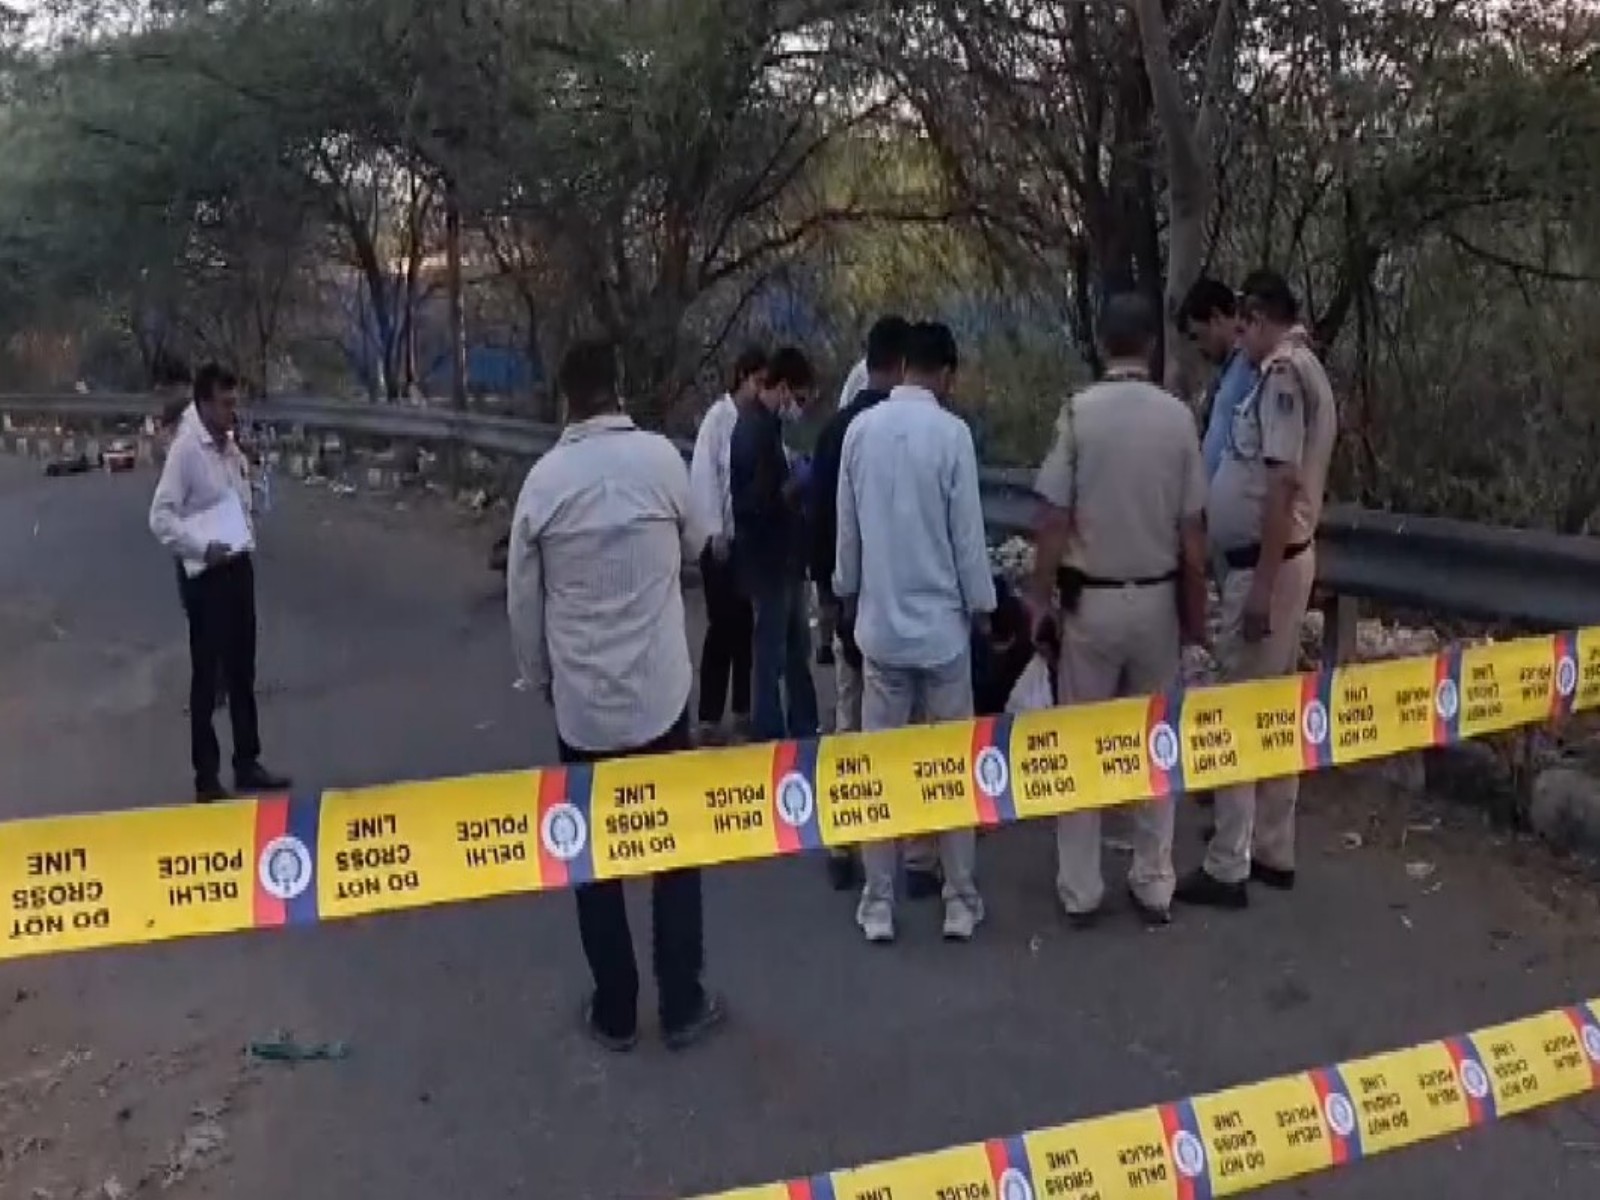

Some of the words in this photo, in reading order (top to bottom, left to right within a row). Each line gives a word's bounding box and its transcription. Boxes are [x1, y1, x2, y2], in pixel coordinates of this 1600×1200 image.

[835, 754, 870, 776] LINE
[913, 756, 965, 779] POLICE
[614, 784, 655, 807] LINE
[705, 784, 765, 807] POLICE
[830, 780, 882, 804] CROSS
[921, 781, 964, 802] DELHI
[606, 809, 669, 833] CROSS
[714, 810, 762, 833] DELHI
[833, 806, 863, 827] NOT
[868, 804, 890, 822] DO
[347, 815, 396, 840] LINE
[457, 815, 528, 840] POLICE
[608, 837, 646, 859] NOT
[650, 834, 675, 852] DO
[27, 848, 86, 874] LINE
[158, 848, 243, 878] POLICE
[336, 845, 410, 871] CROSS
[467, 844, 525, 867] DELHI
[335, 877, 382, 899] NOT
[388, 871, 419, 891] DO
[12, 883, 103, 908] CROSS
[170, 882, 238, 905] DELHI
[9, 914, 63, 940] NOT
[73, 909, 110, 929] DO
